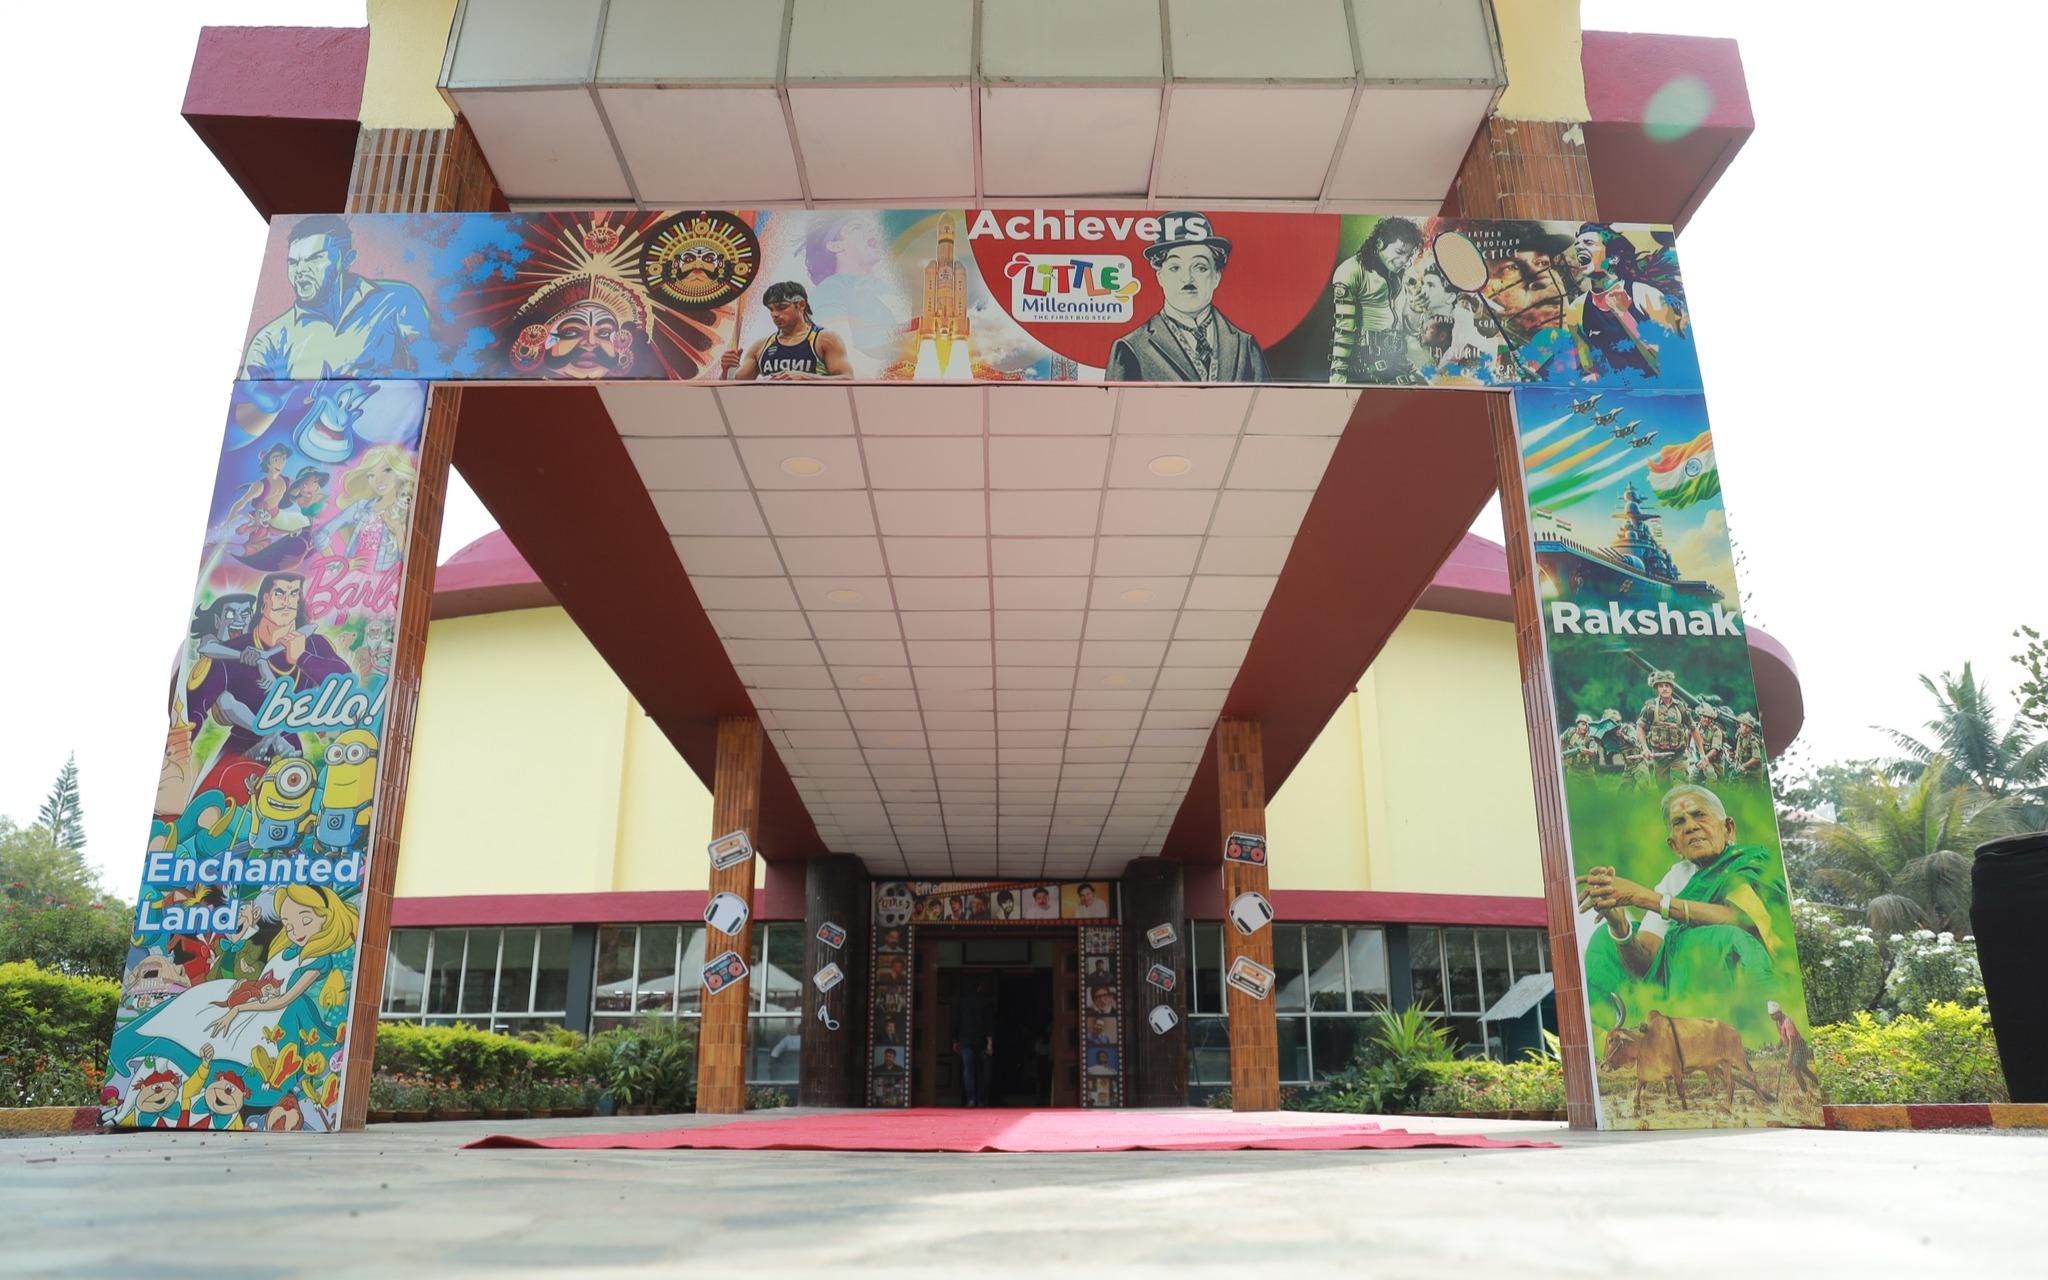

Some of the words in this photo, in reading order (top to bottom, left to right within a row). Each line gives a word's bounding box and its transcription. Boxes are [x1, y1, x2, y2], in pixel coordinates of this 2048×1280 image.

[968, 210, 1208, 242] Achievers
[1022, 297, 1123, 312] Millennium
[1551, 601, 1742, 636] Rakshak
[257, 678, 388, 729] bello!
[147, 851, 360, 883] Enchanted
[915, 881, 989, 896] Entertainment
[138, 900, 240, 931] Land
